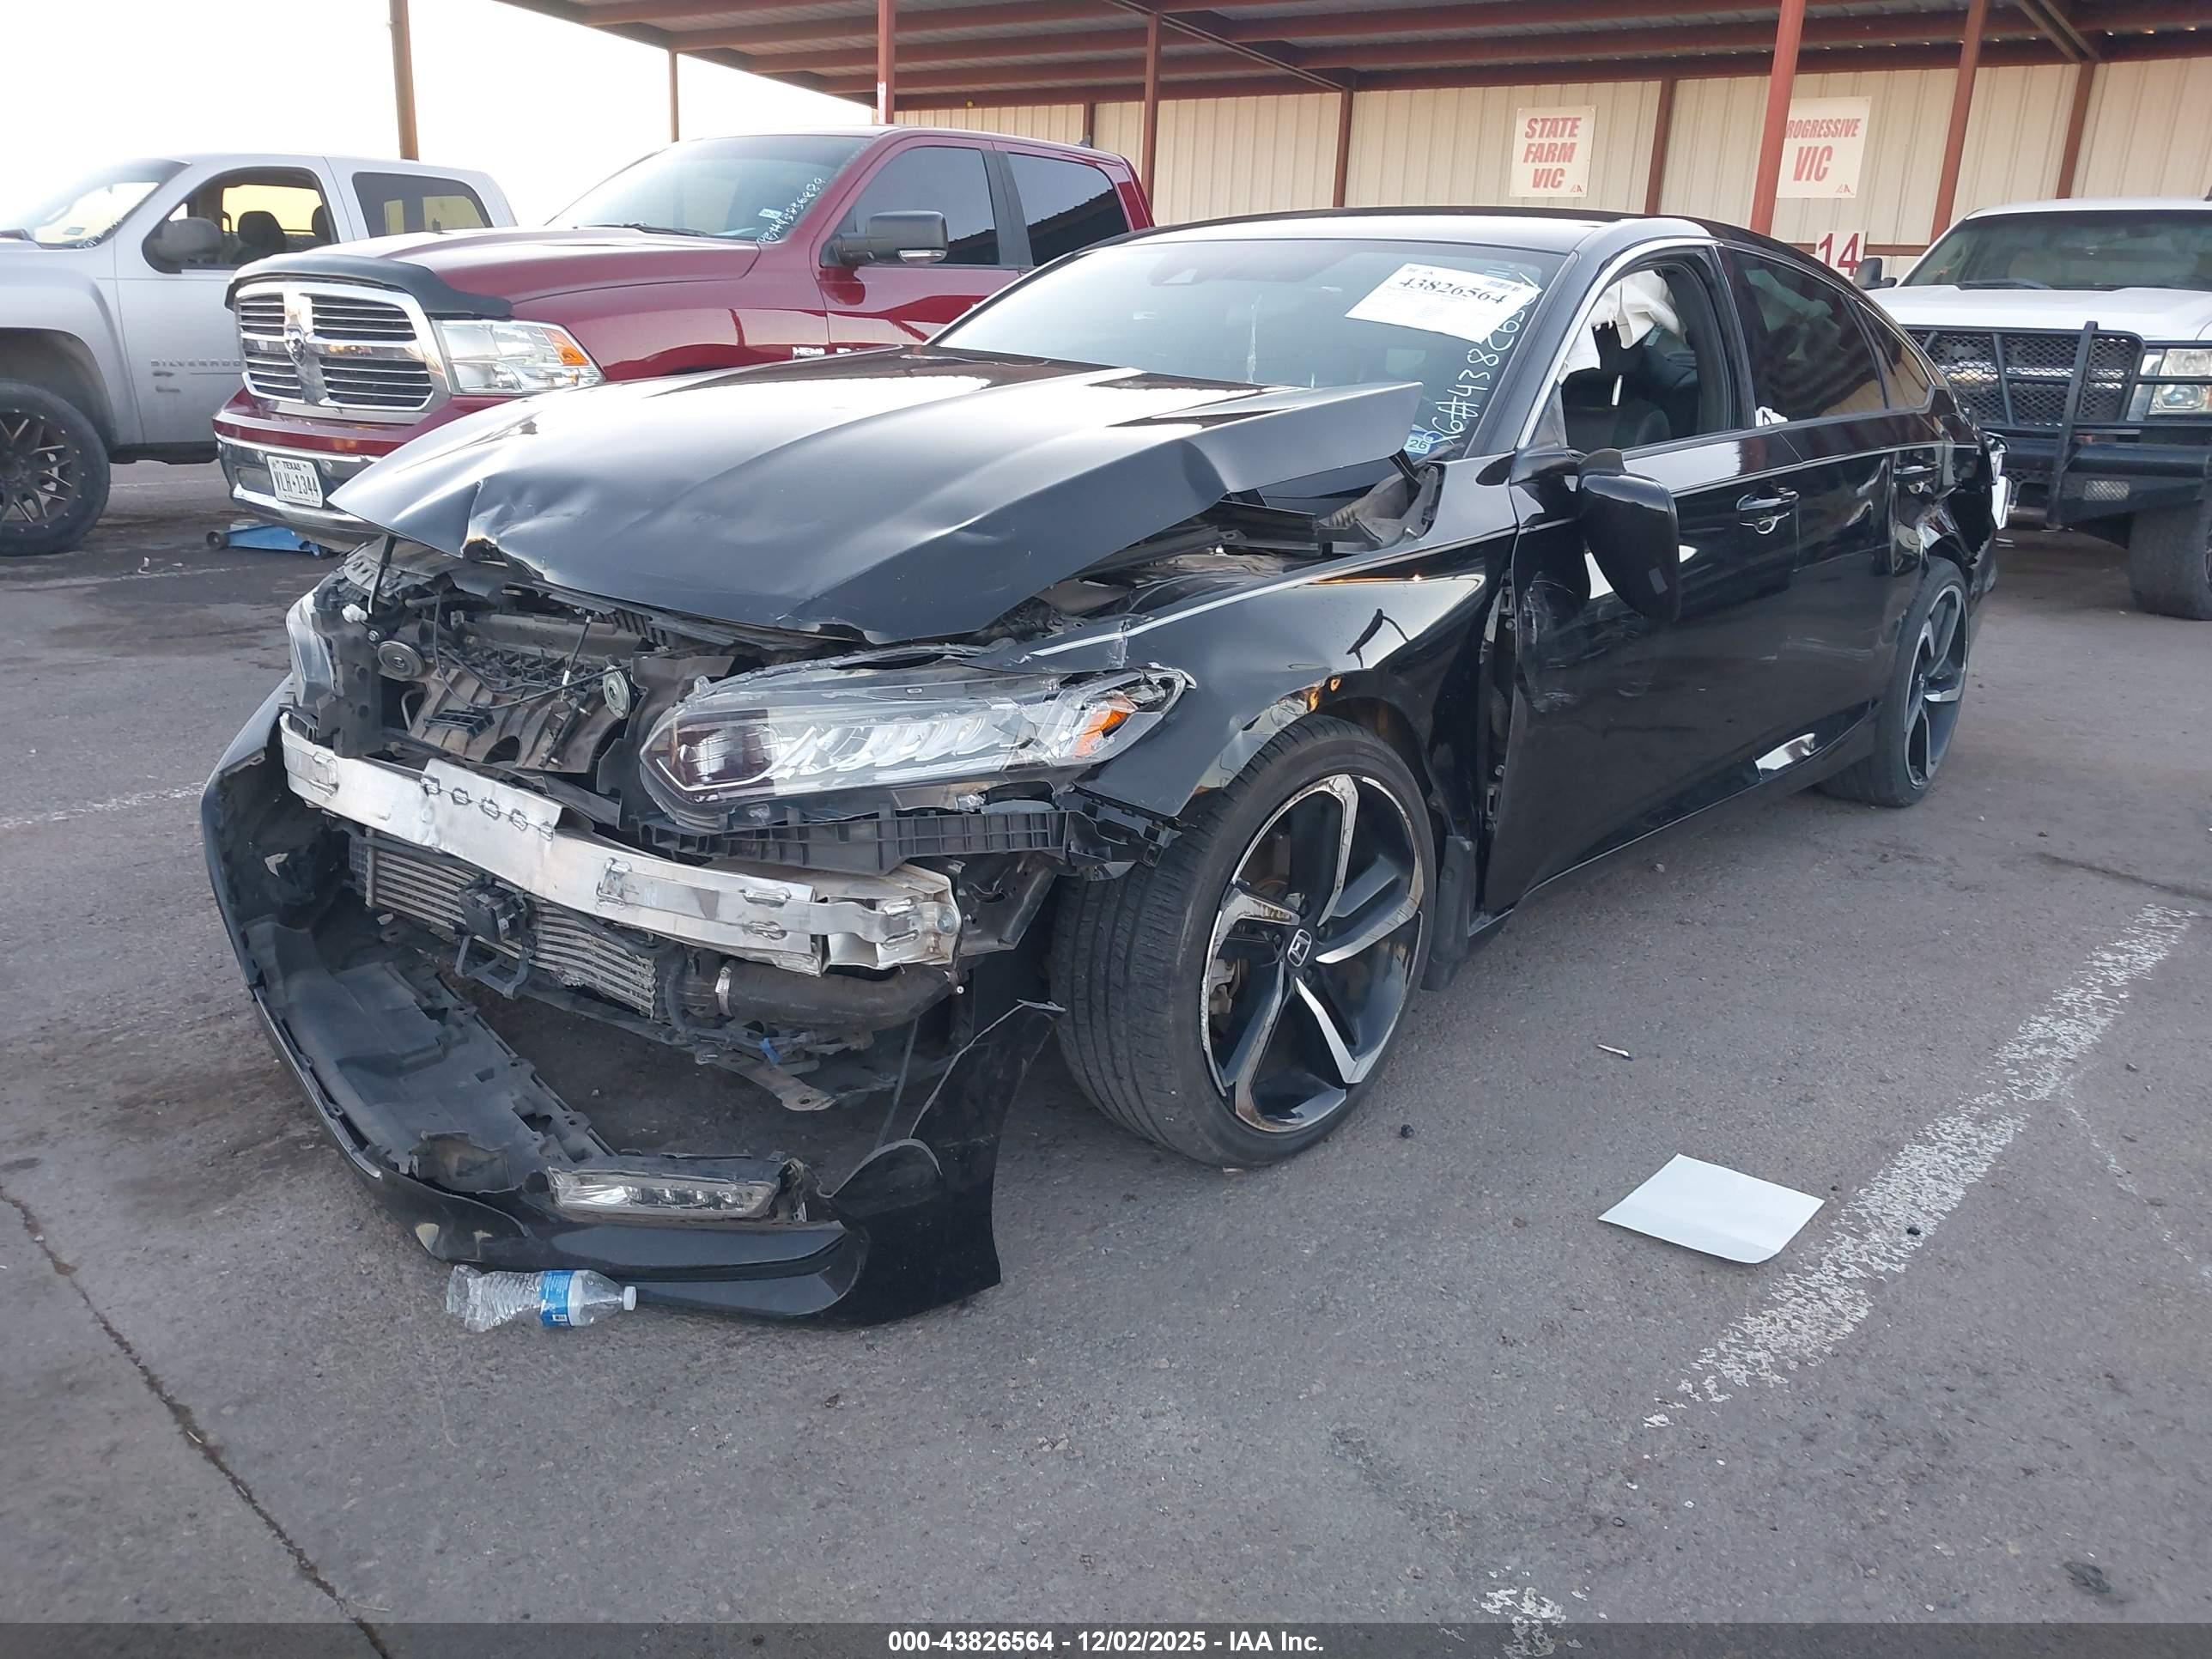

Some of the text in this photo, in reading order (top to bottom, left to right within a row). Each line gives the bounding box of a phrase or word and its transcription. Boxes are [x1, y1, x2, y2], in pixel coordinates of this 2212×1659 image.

[1524, 117, 1582, 138] STATE
[1786, 118, 1861, 138] ROGRESSIVE
[1522, 142, 1577, 163] FARM
[1793, 145, 1833, 181] VIC
[1531, 167, 1565, 189] VIC
[1819, 232, 1861, 276] 14
[1399, 276, 1509, 305] 43826564
[1408, 439, 1428, 450] 26
